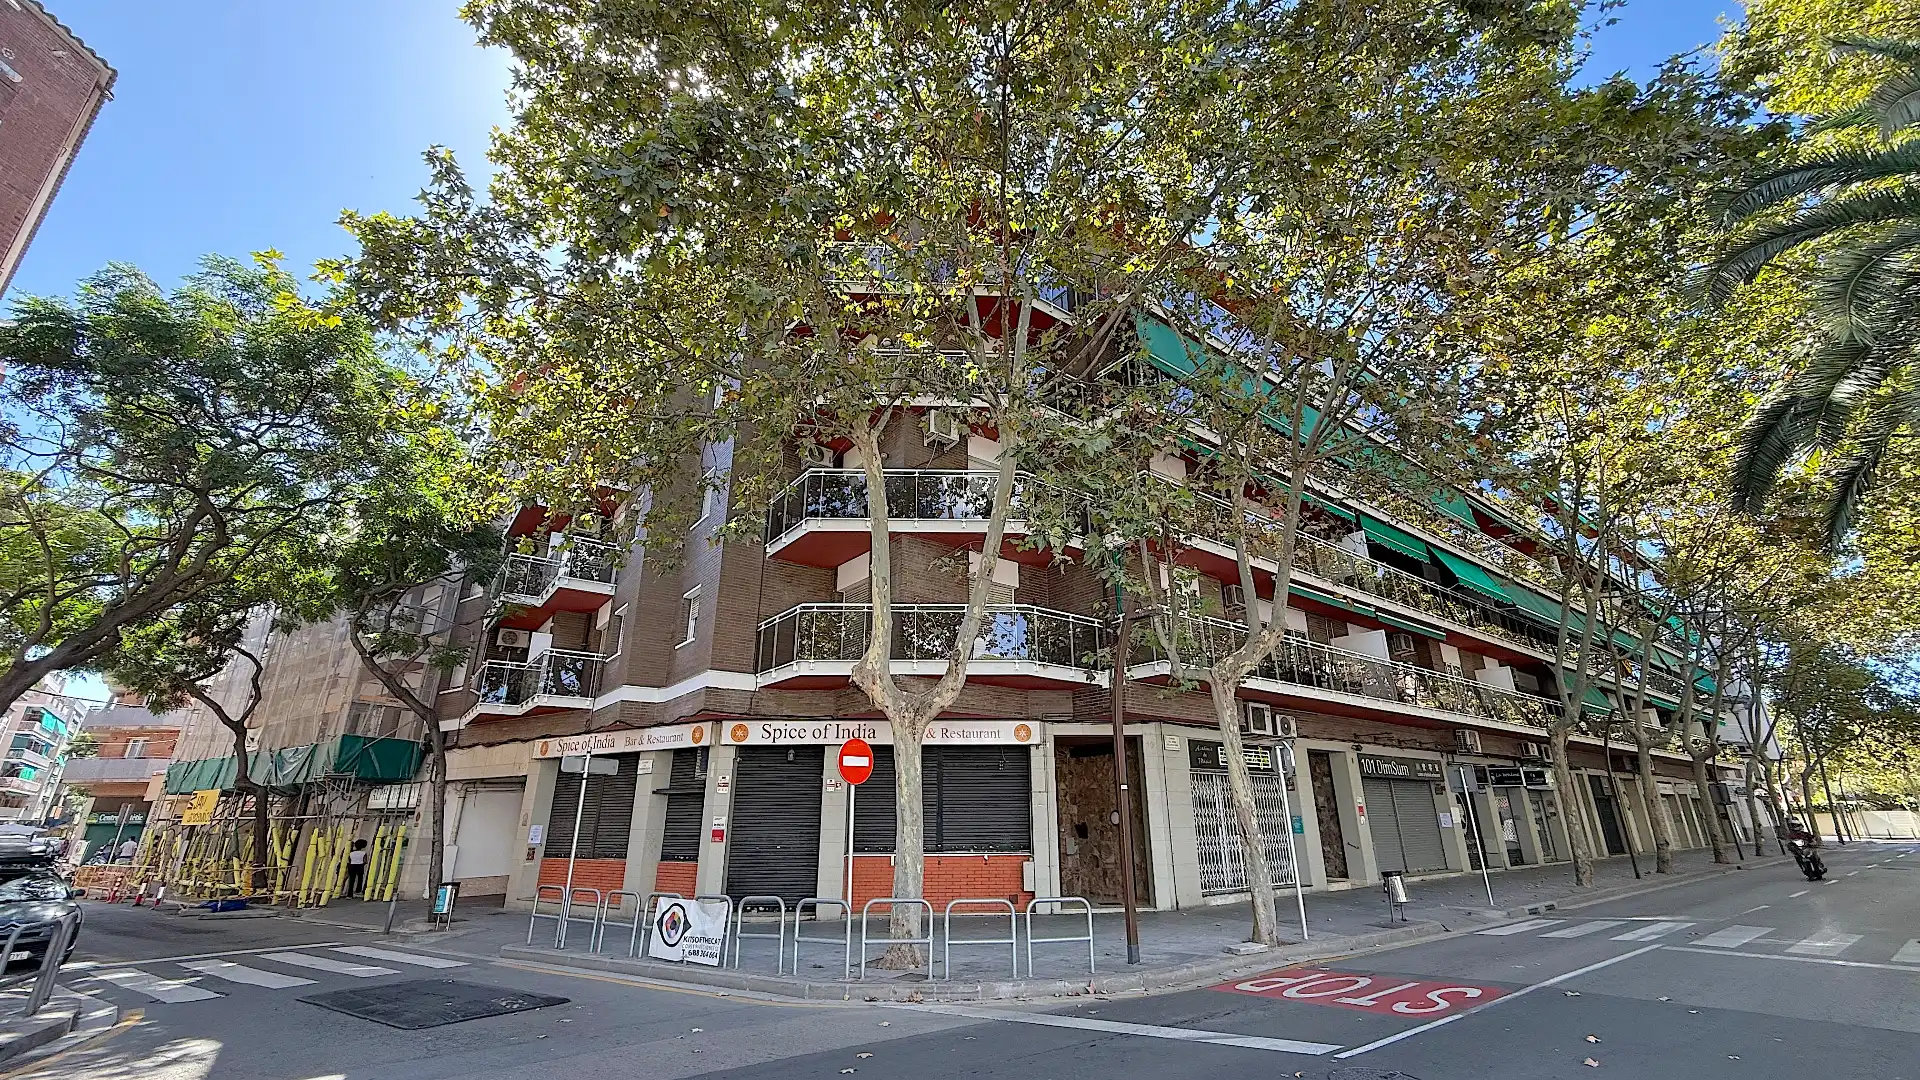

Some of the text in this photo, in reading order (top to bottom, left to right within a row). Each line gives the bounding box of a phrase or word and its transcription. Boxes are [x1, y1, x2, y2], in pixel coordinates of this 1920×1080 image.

[624, 732, 685, 747] Bar & Restaurant
[761, 723, 877, 743] Spice of India
[925, 727, 1002, 740] & Restaurant
[556, 733, 616, 755] Spice of India
[1361, 758, 1377, 774] 101
[1234, 973, 1483, 1014] STOP
